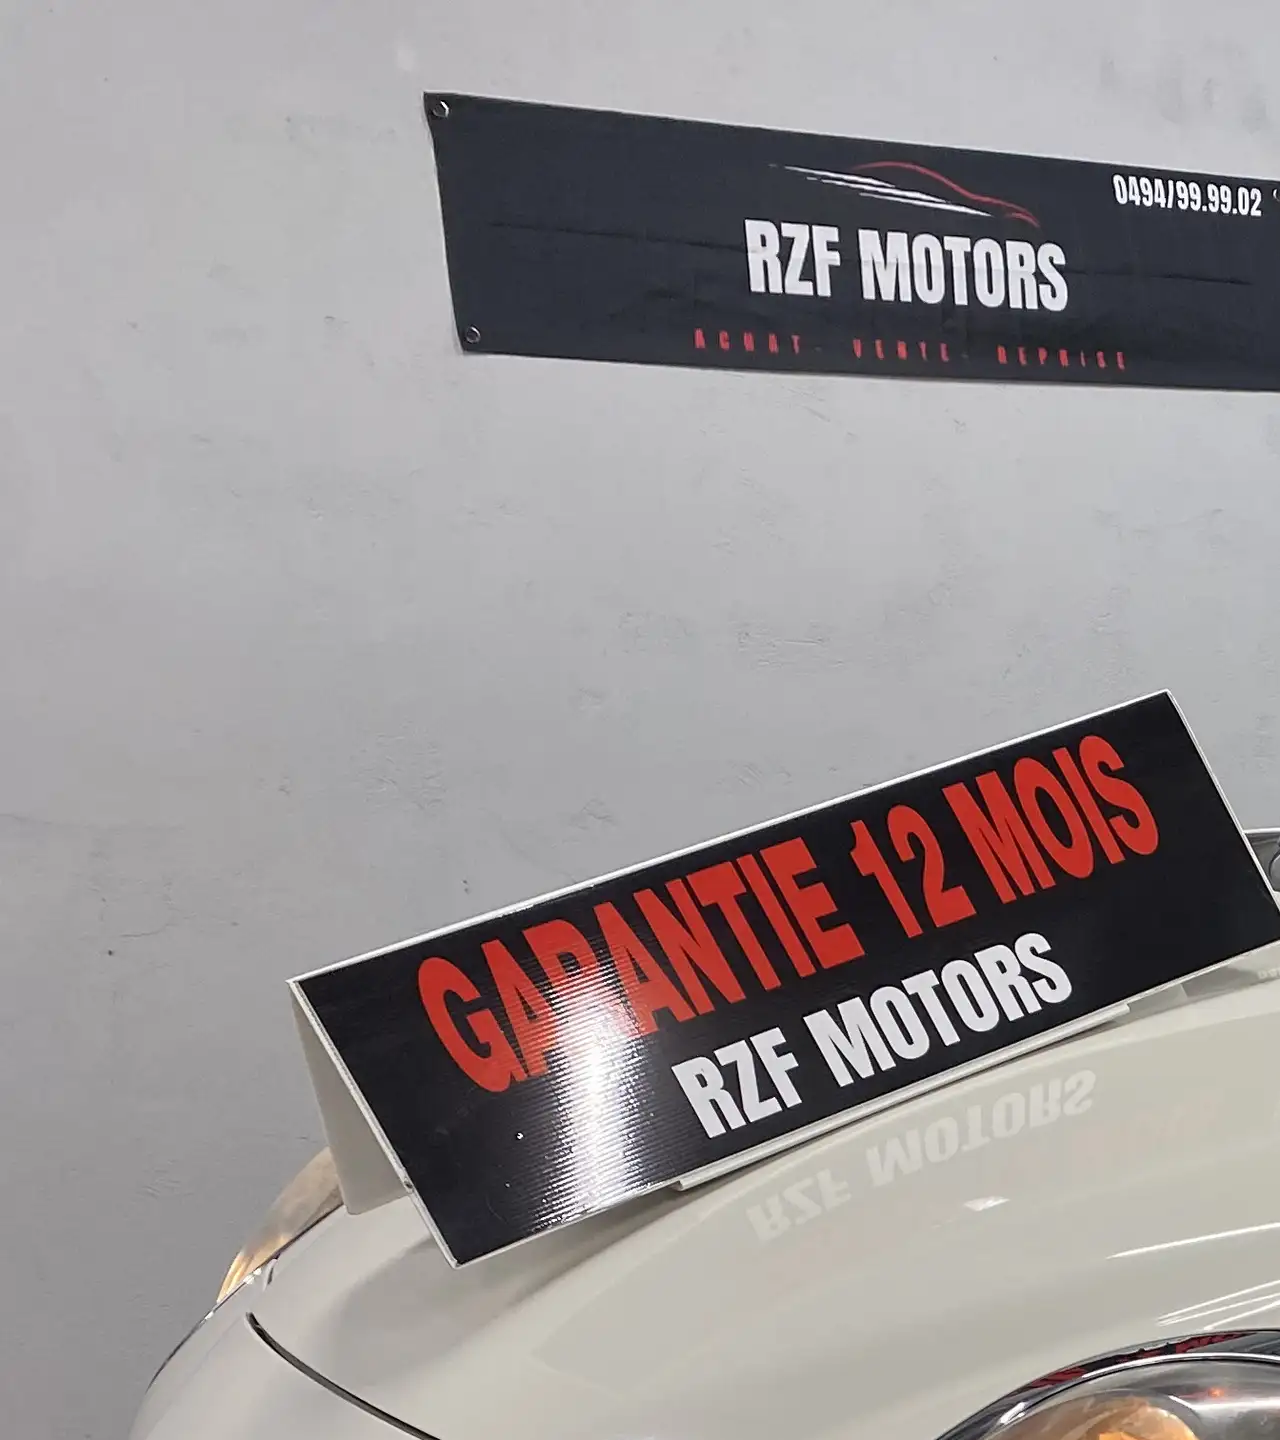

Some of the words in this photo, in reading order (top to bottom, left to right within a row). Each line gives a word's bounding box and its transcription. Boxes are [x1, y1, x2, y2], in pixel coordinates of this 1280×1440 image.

[744, 218, 841, 298] RZF
[857, 228, 1068, 312] MOTORS
[1112, 174, 1262, 217] 0494/99.99.02
[416, 837, 866, 1094] GARANTIE
[850, 803, 971, 939] 12
[942, 733, 1161, 905] MOIS
[671, 1038, 803, 1139] RZF
[803, 931, 1074, 1088] MOTORS
